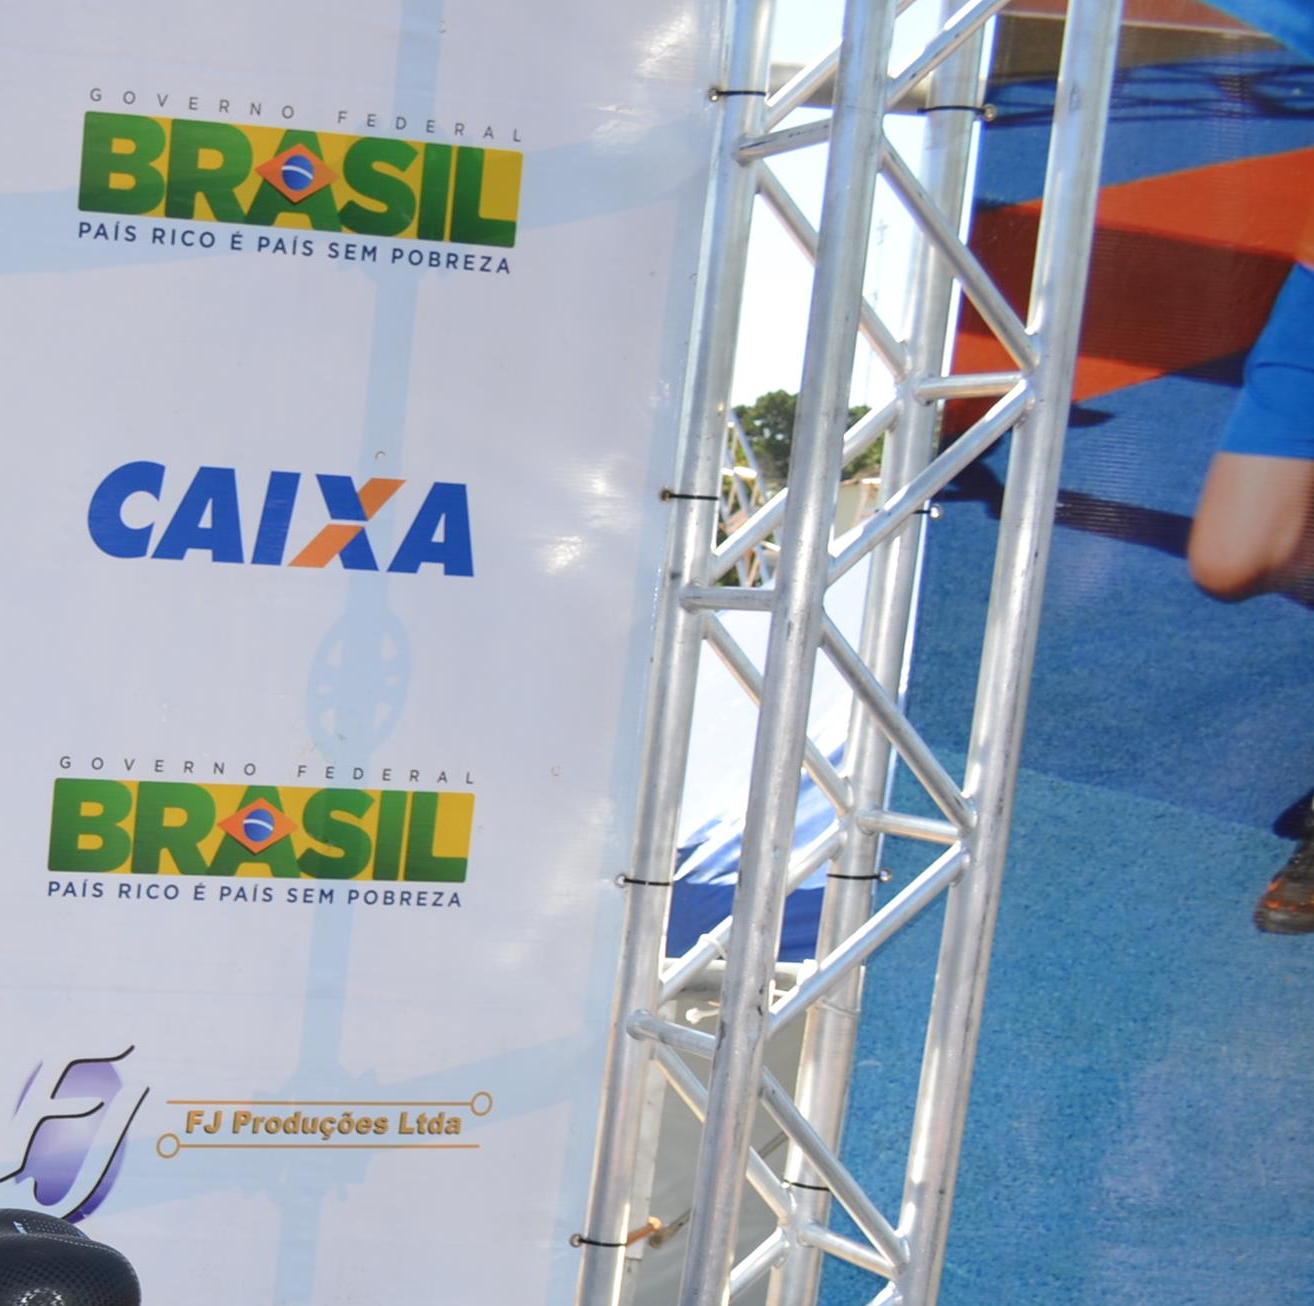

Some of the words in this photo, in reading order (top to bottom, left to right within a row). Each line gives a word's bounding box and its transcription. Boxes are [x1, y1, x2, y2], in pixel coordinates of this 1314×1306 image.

[88, 87, 296, 120] GOVERNO
[337, 110, 523, 143] FEDERAL
[78, 111, 522, 248] BRASIL
[78, 221, 137, 244] PAÍS
[151, 227, 216, 250] RICO
[230, 231, 244, 253] É
[257, 235, 314, 257] PAÍS
[328, 241, 378, 263] SEM
[391, 248, 512, 275] POBREZA
[87, 461, 474, 577] CAIXA
[58, 756, 257, 777] GOVERNO
[297, 765, 476, 785] FEDERAL
[47, 777, 474, 883] BRASIL
[47, 880, 104, 900] PAÍS
[118, 882, 180, 901] RICO
[192, 881, 206, 902] É
[219, 883, 275, 904] PAÍS
[287, 887, 335, 905] SEM
[348, 888, 462, 908] POBREZA
[185, 1110, 223, 1135] FJ
[232, 1110, 390, 1141] Produções
[398, 1112, 462, 1137] Ltda
